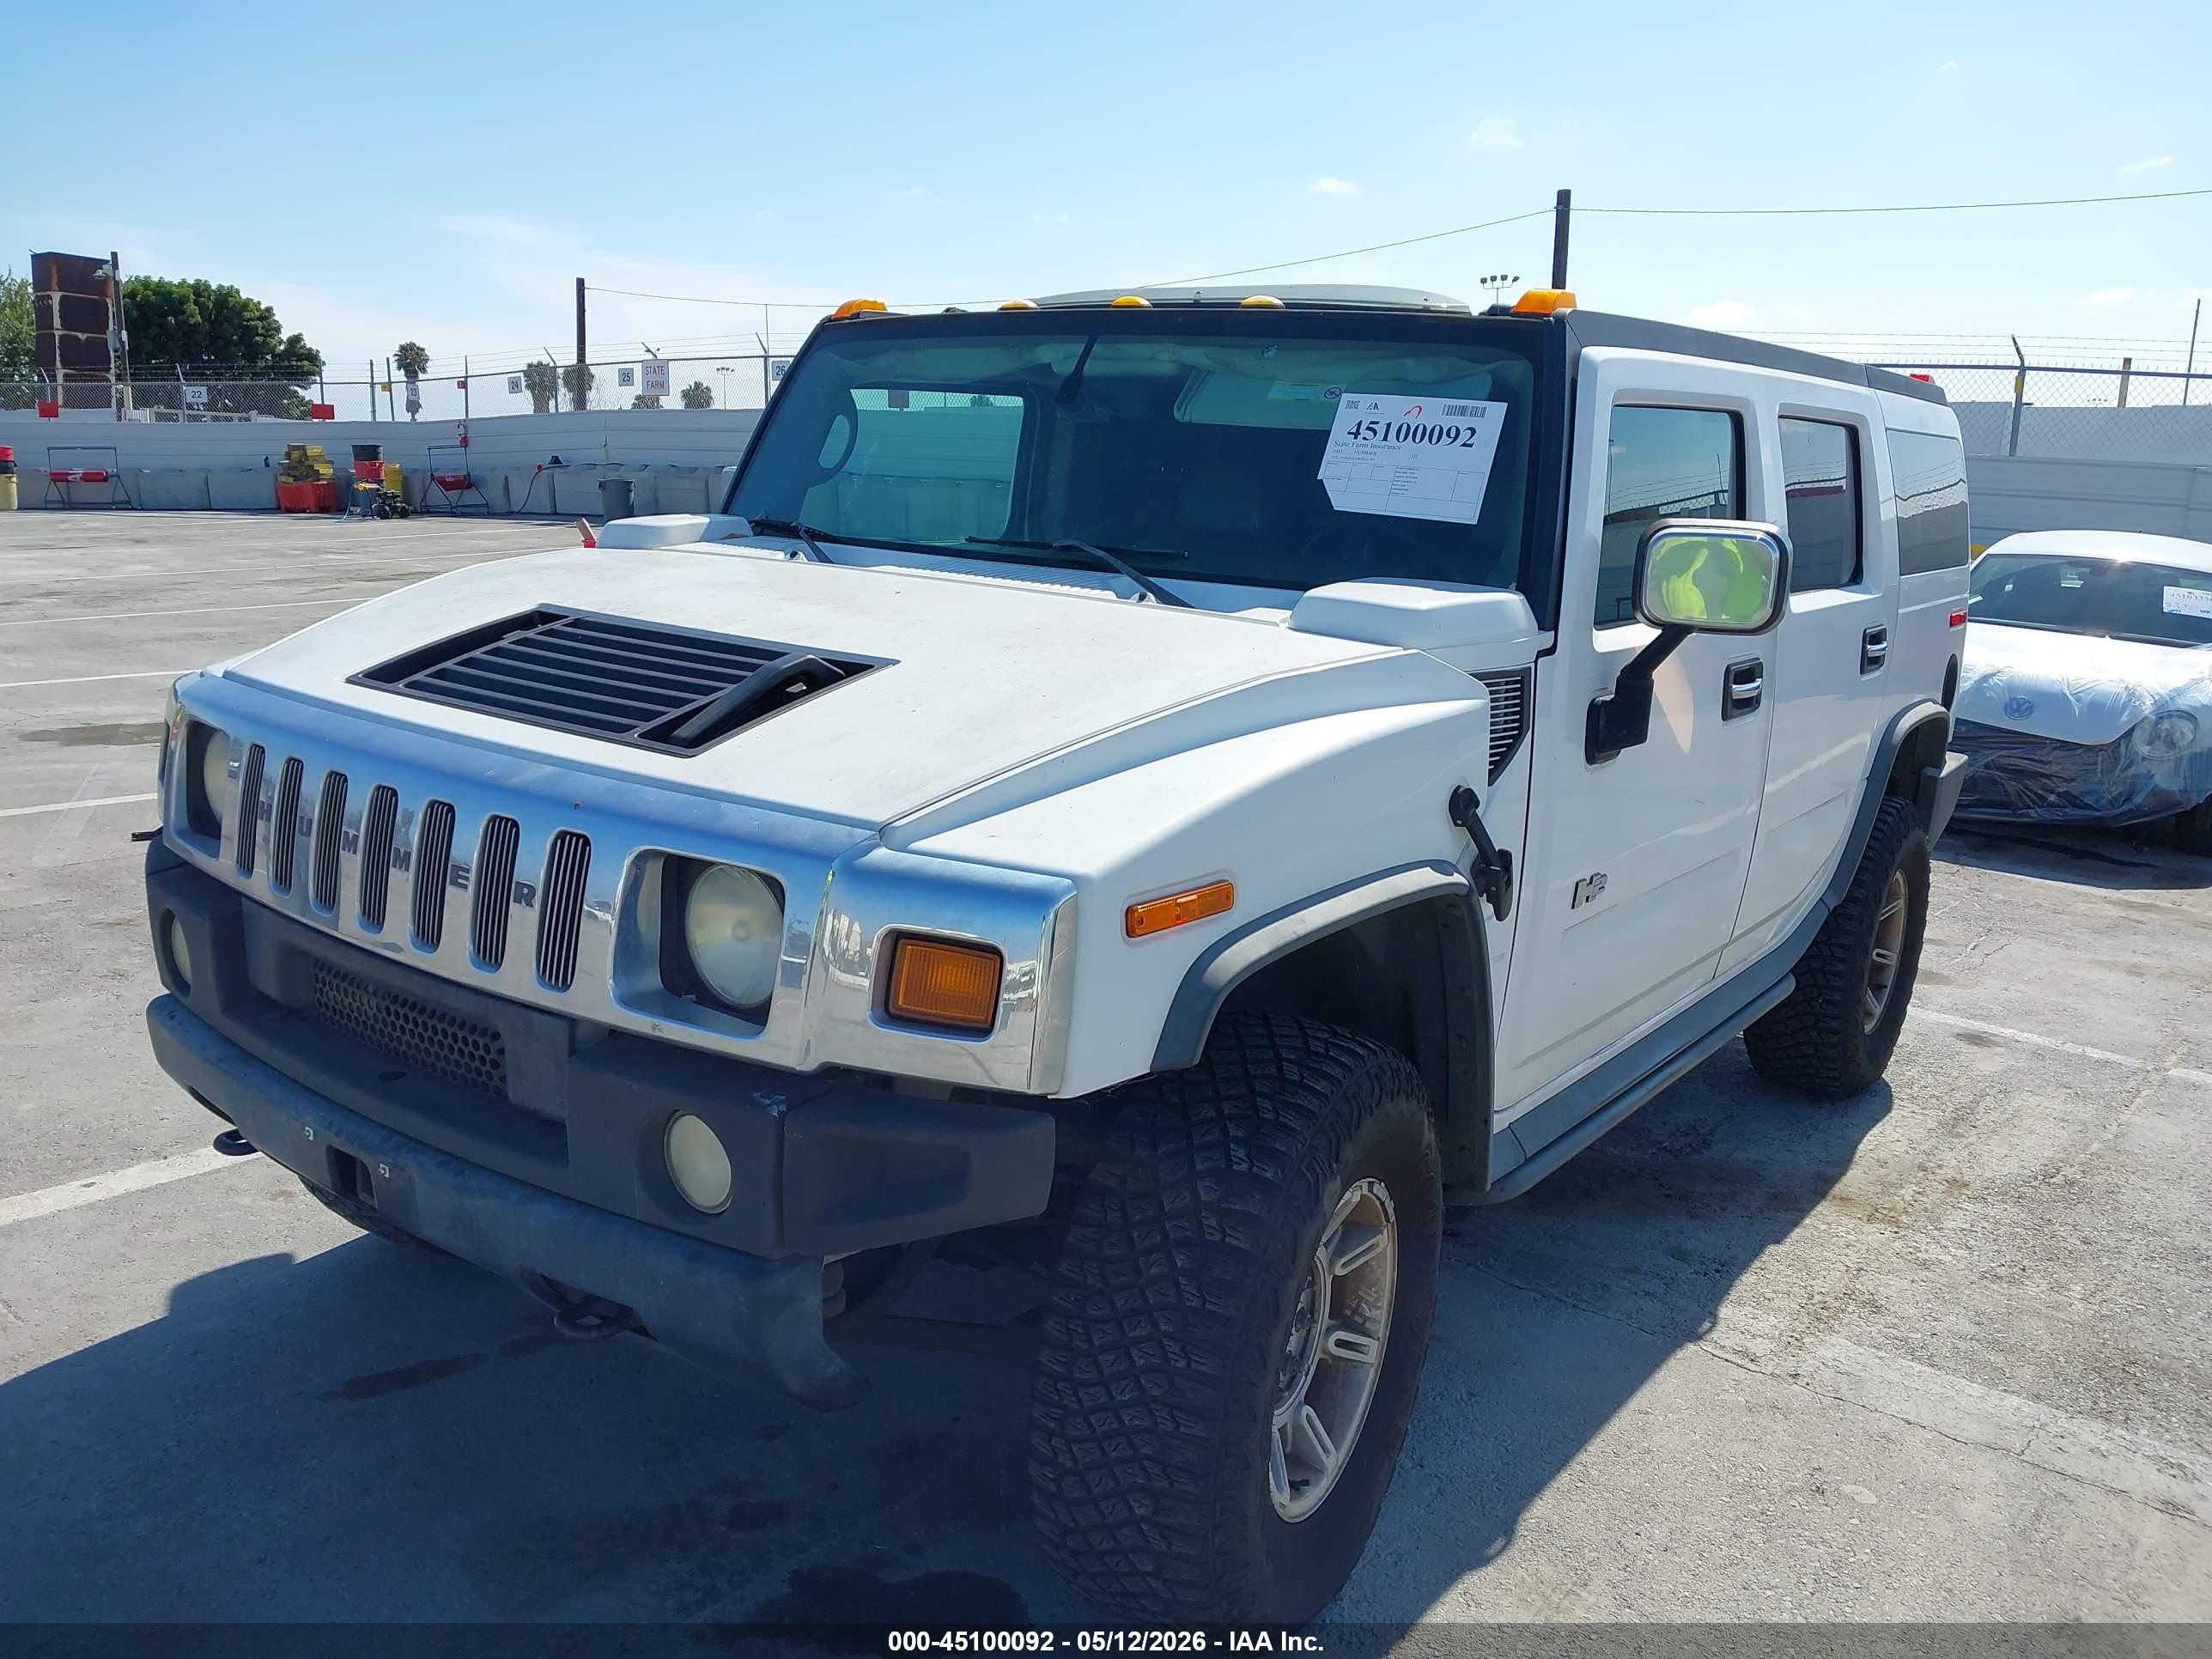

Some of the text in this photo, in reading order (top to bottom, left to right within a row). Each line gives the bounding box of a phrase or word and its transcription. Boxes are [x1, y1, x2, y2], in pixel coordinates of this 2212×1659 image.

[645, 366, 665, 376] STATE
[775, 365, 786, 376] 26
[622, 372, 631, 382] 25
[511, 380, 519, 390] 24
[646, 380, 665, 390] FARM
[191, 390, 203, 399] 22
[1346, 419, 1477, 448] 45100092
[1370, 442, 1402, 451] Insurance
[258, 799, 537, 908] HUMMER
[1571, 872, 1608, 909] H2
